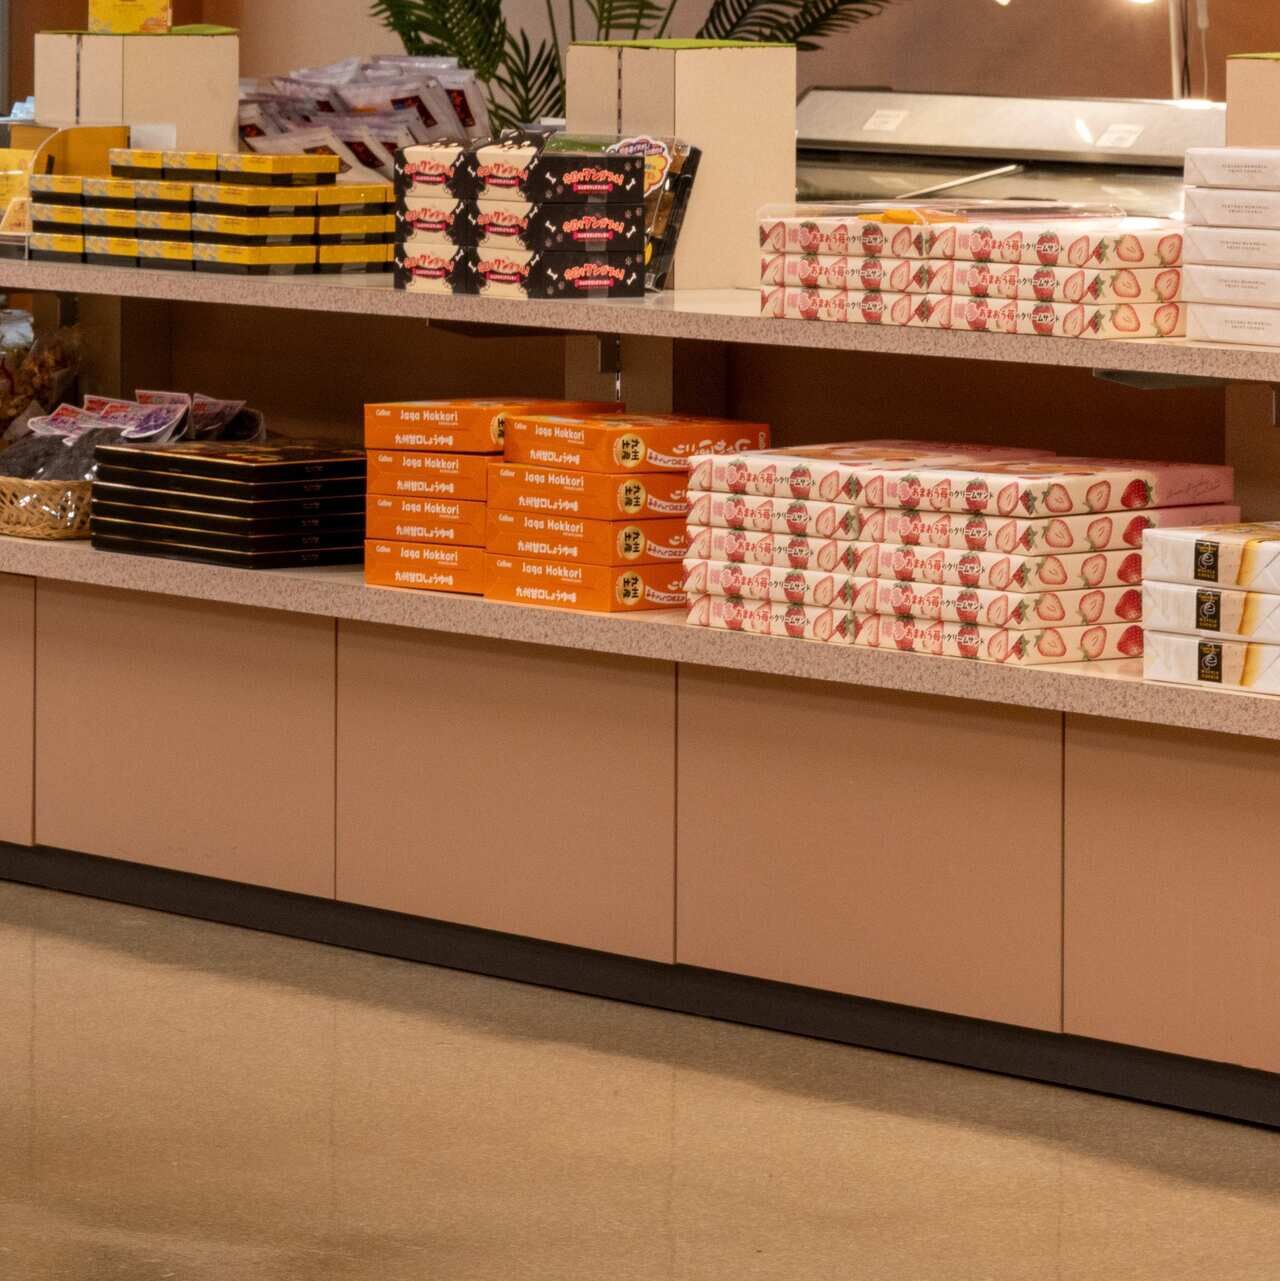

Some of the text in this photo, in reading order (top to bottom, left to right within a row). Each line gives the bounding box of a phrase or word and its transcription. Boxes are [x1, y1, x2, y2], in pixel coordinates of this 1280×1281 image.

[423, 410, 458, 421] Hokkori
[554, 426, 584, 440] Hokkori
[424, 457, 459, 470] Hokkori
[548, 473, 584, 486] Hokkori
[424, 503, 459, 515] Hokkori
[545, 564, 582, 578] Hokkori
